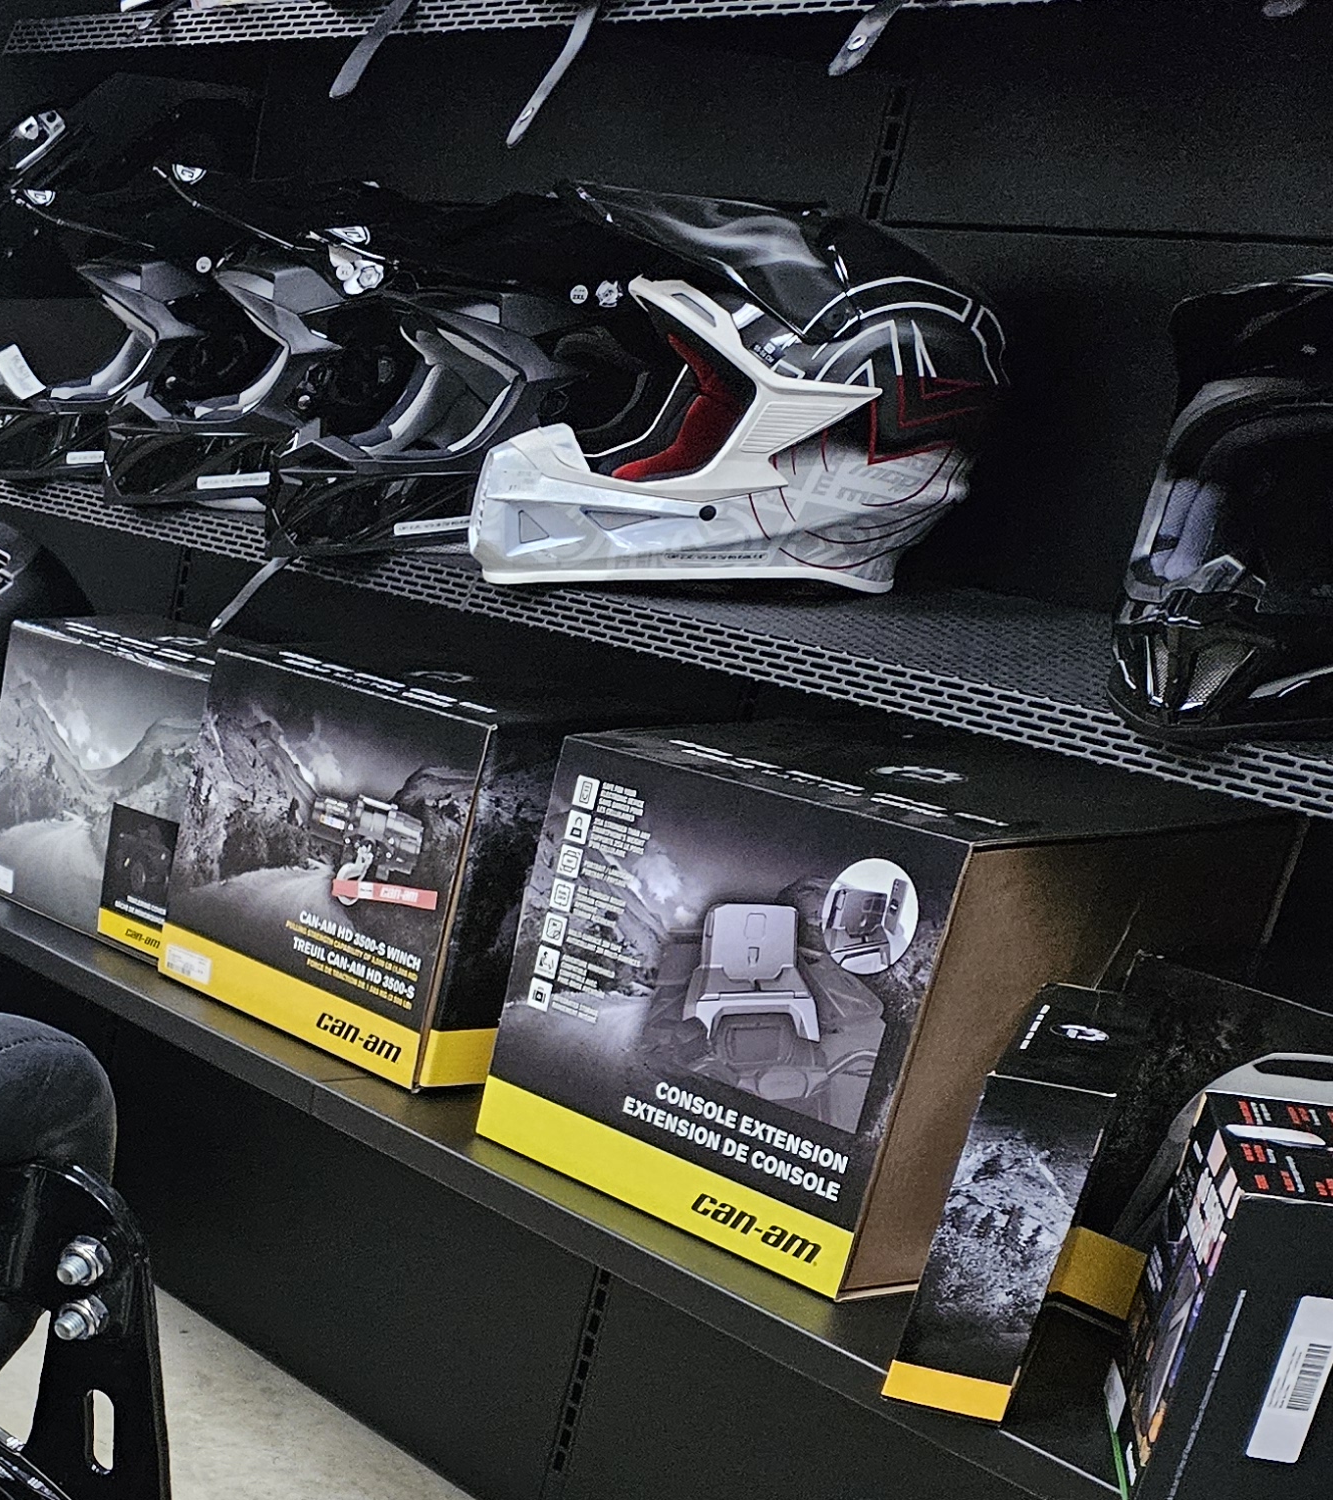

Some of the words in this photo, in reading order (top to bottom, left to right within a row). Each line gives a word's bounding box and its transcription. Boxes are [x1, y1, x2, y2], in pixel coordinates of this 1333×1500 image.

[125, 928, 161, 949] can-am
[293, 936, 326, 961] TREUIL
[327, 951, 365, 979] CAN-AM
[366, 968, 382, 985] HD
[382, 976, 416, 999] 3500-S
[299, 911, 336, 935] CAN-AM
[337, 926, 353, 942] HD
[353, 932, 385, 956] 3500-S
[386, 944, 421, 971] WINCH
[315, 1012, 402, 1063] can-am
[622, 1096, 721, 1151] EXTENSION
[722, 1138, 750, 1164] DE
[751, 1150, 841, 1202] CONSOLE
[655, 1082, 738, 1129] CONSOLE
[739, 1115, 849, 1174] EXTENSION
[691, 1193, 823, 1264] can-am
